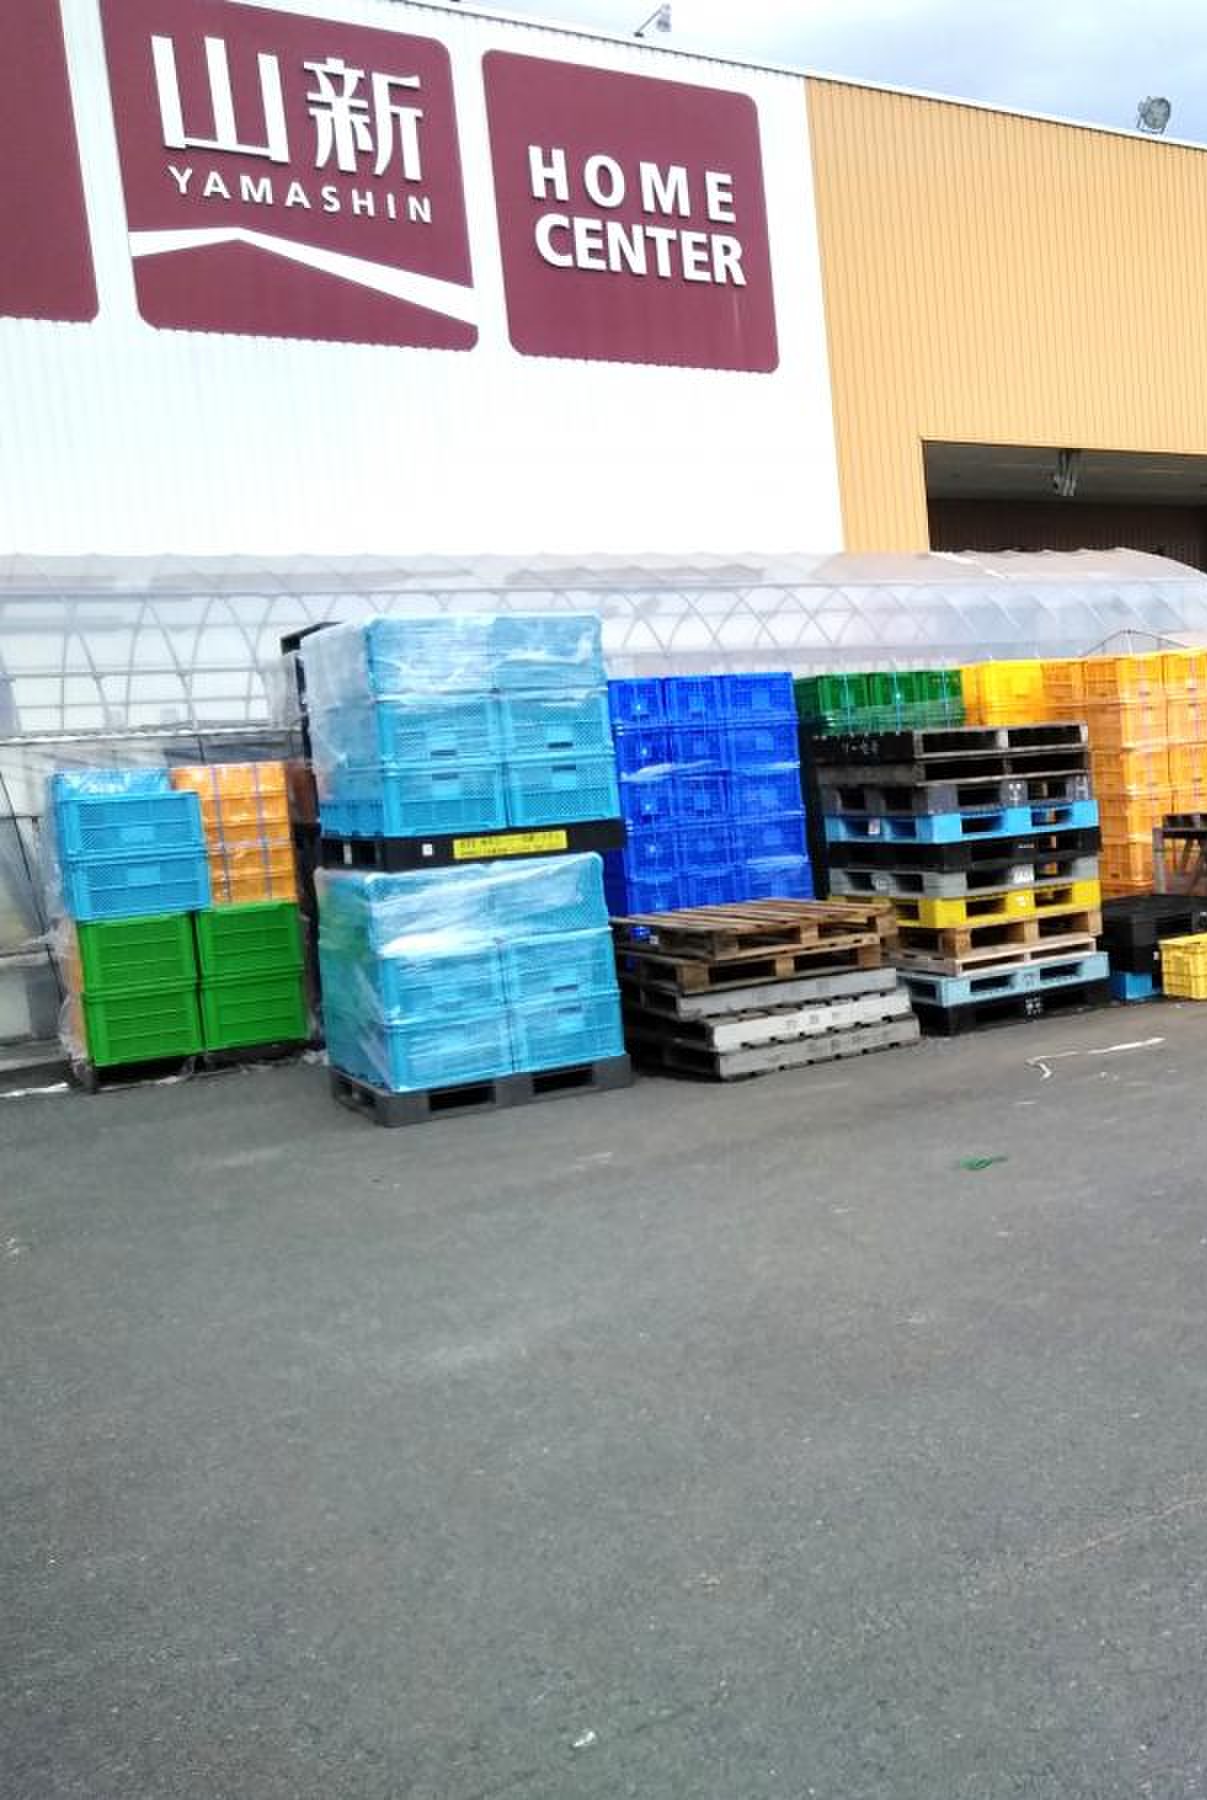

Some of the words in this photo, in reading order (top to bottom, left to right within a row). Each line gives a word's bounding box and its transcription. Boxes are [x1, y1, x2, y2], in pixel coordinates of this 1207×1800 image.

[151, 35, 422, 182] 山新
[168, 165, 433, 224] YAMASHIN
[527, 145, 737, 224] HOME
[534, 213, 747, 287] CENTER
